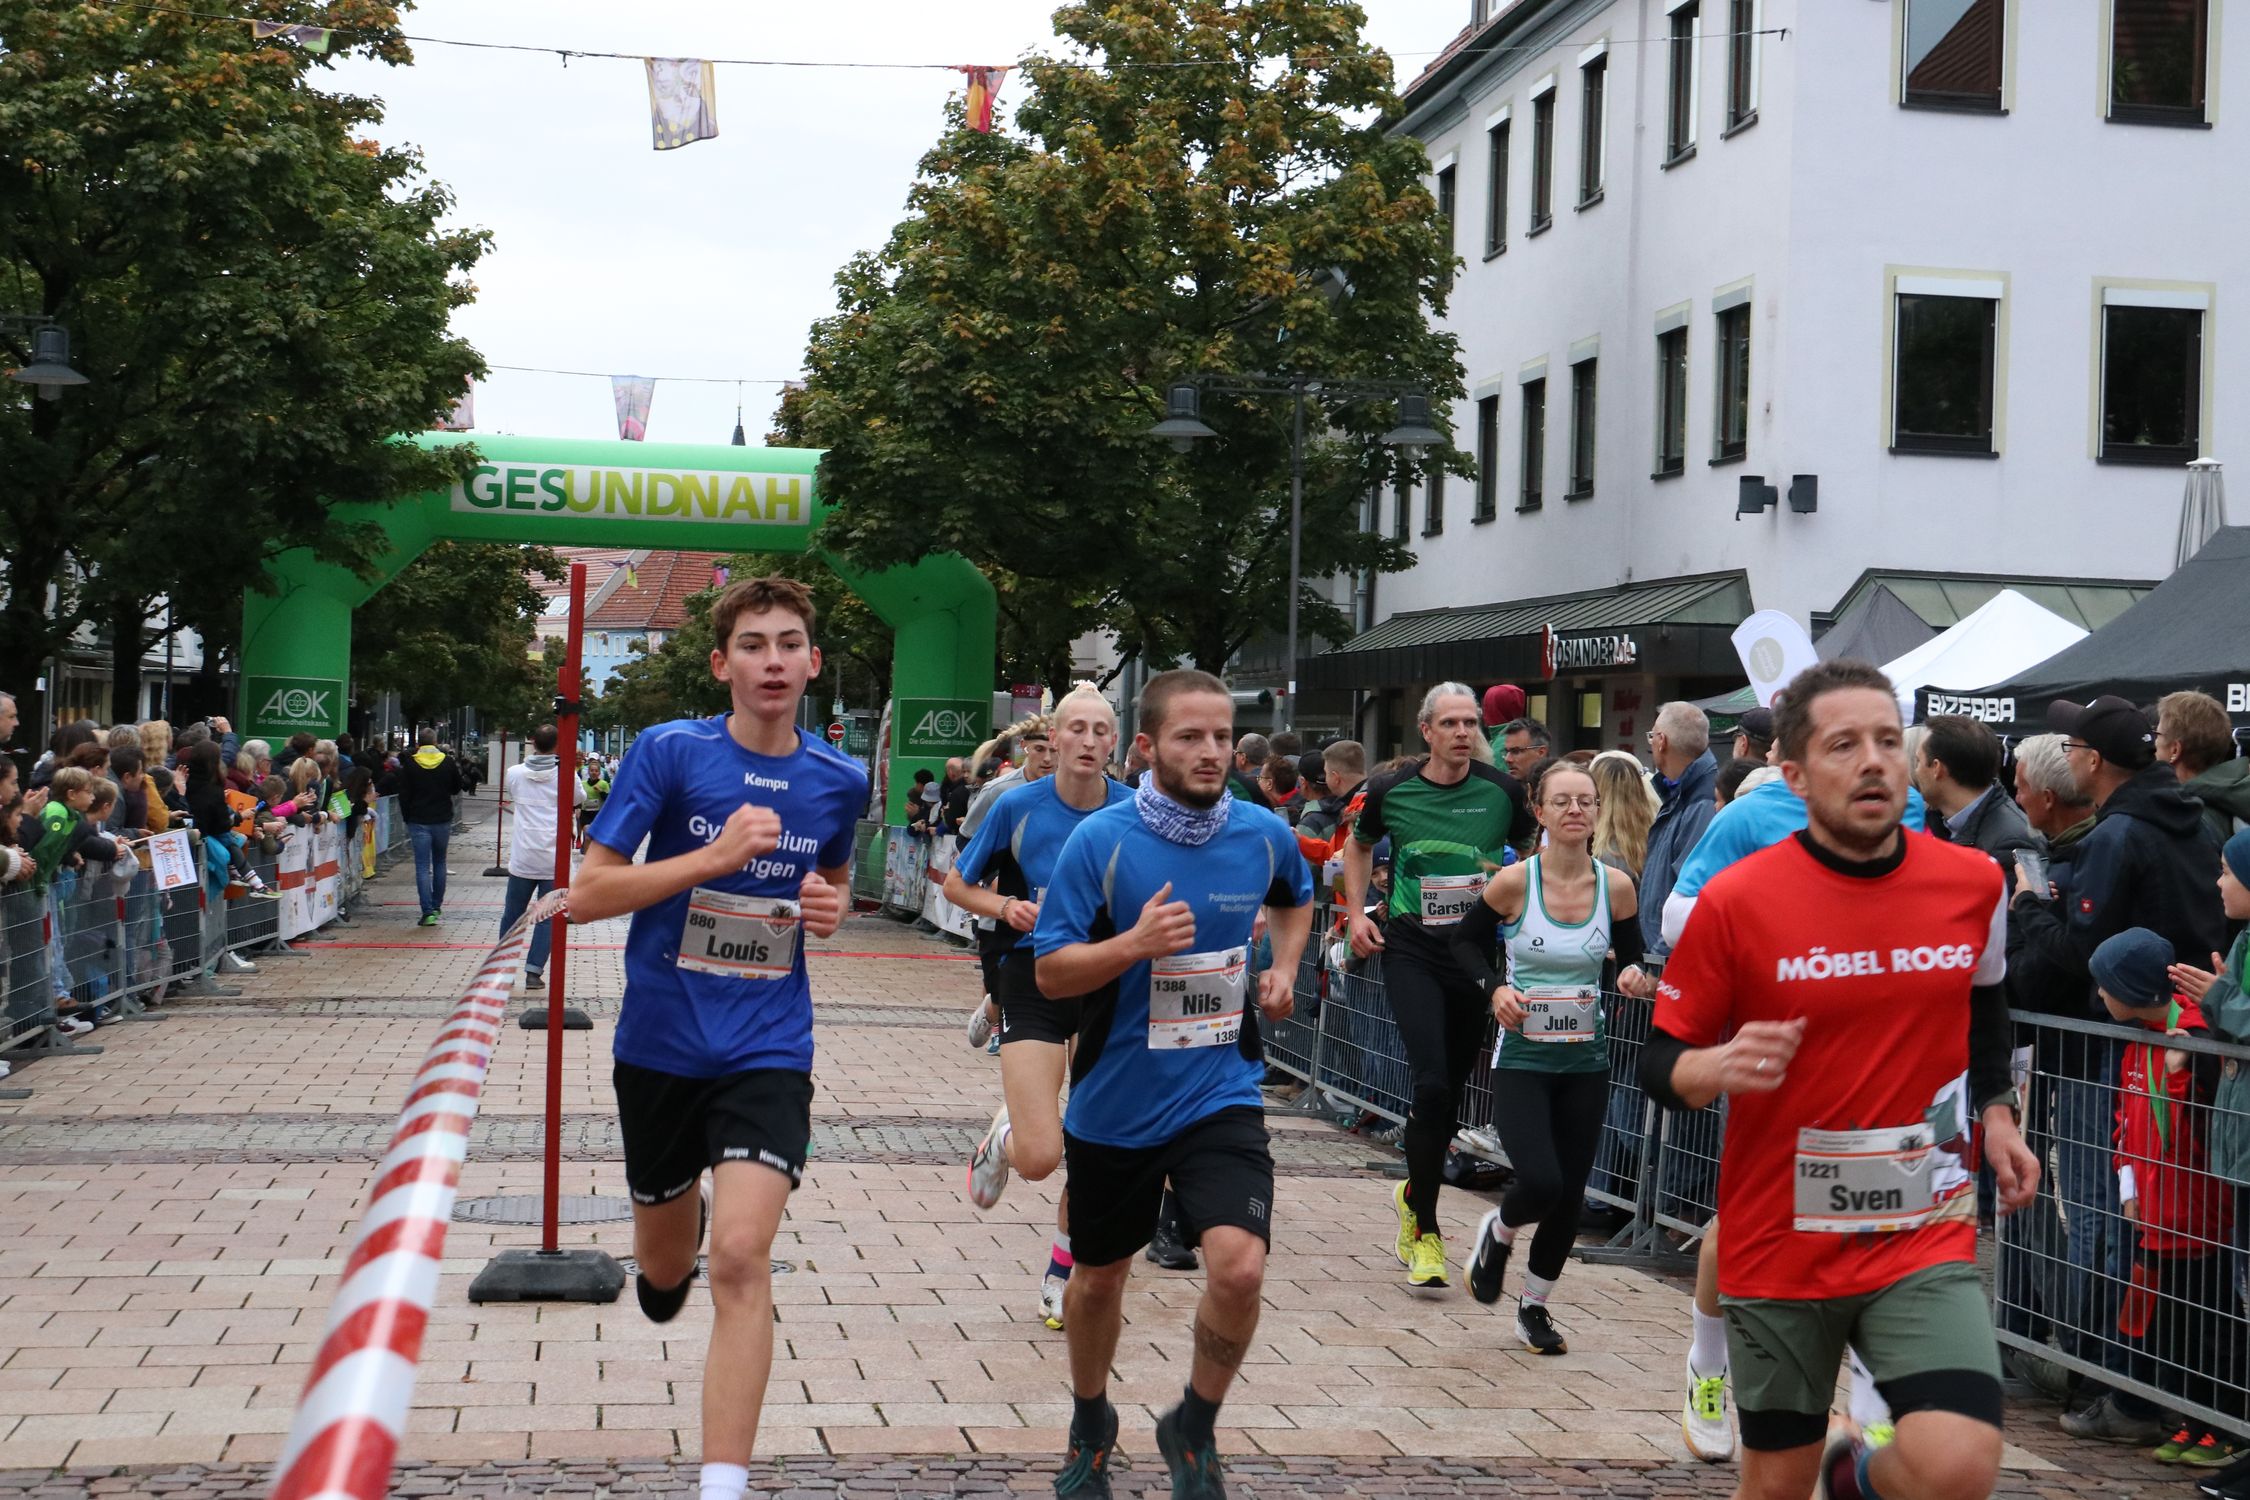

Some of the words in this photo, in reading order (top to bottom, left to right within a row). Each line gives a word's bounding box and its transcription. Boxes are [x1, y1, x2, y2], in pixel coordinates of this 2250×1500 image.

[258, 689, 330, 719] AOK
[1927, 693, 2015, 723] BIZERBA
[256, 717, 267, 725] Die
[911, 710, 978, 738] AOK
[744, 772, 789, 792] Kempa
[688, 815, 819, 855] Gysium
[1422, 892, 1438, 900] 832
[1427, 900, 1475, 916] Carste
[689, 913, 716, 930] 880
[706, 935, 769, 962] Louis
[1776, 946, 1885, 982] MÖBEL
[1890, 943, 1975, 973] ROGG
[1154, 980, 1187, 992] 1388
[1182, 993, 1222, 1015] Nils
[1525, 1003, 1549, 1013] 1478
[1544, 1015, 1578, 1031] Jule
[1215, 1028, 1239, 1043] 1388
[1798, 1162, 1840, 1179] 1221
[1829, 1184, 1903, 1212] Sven
